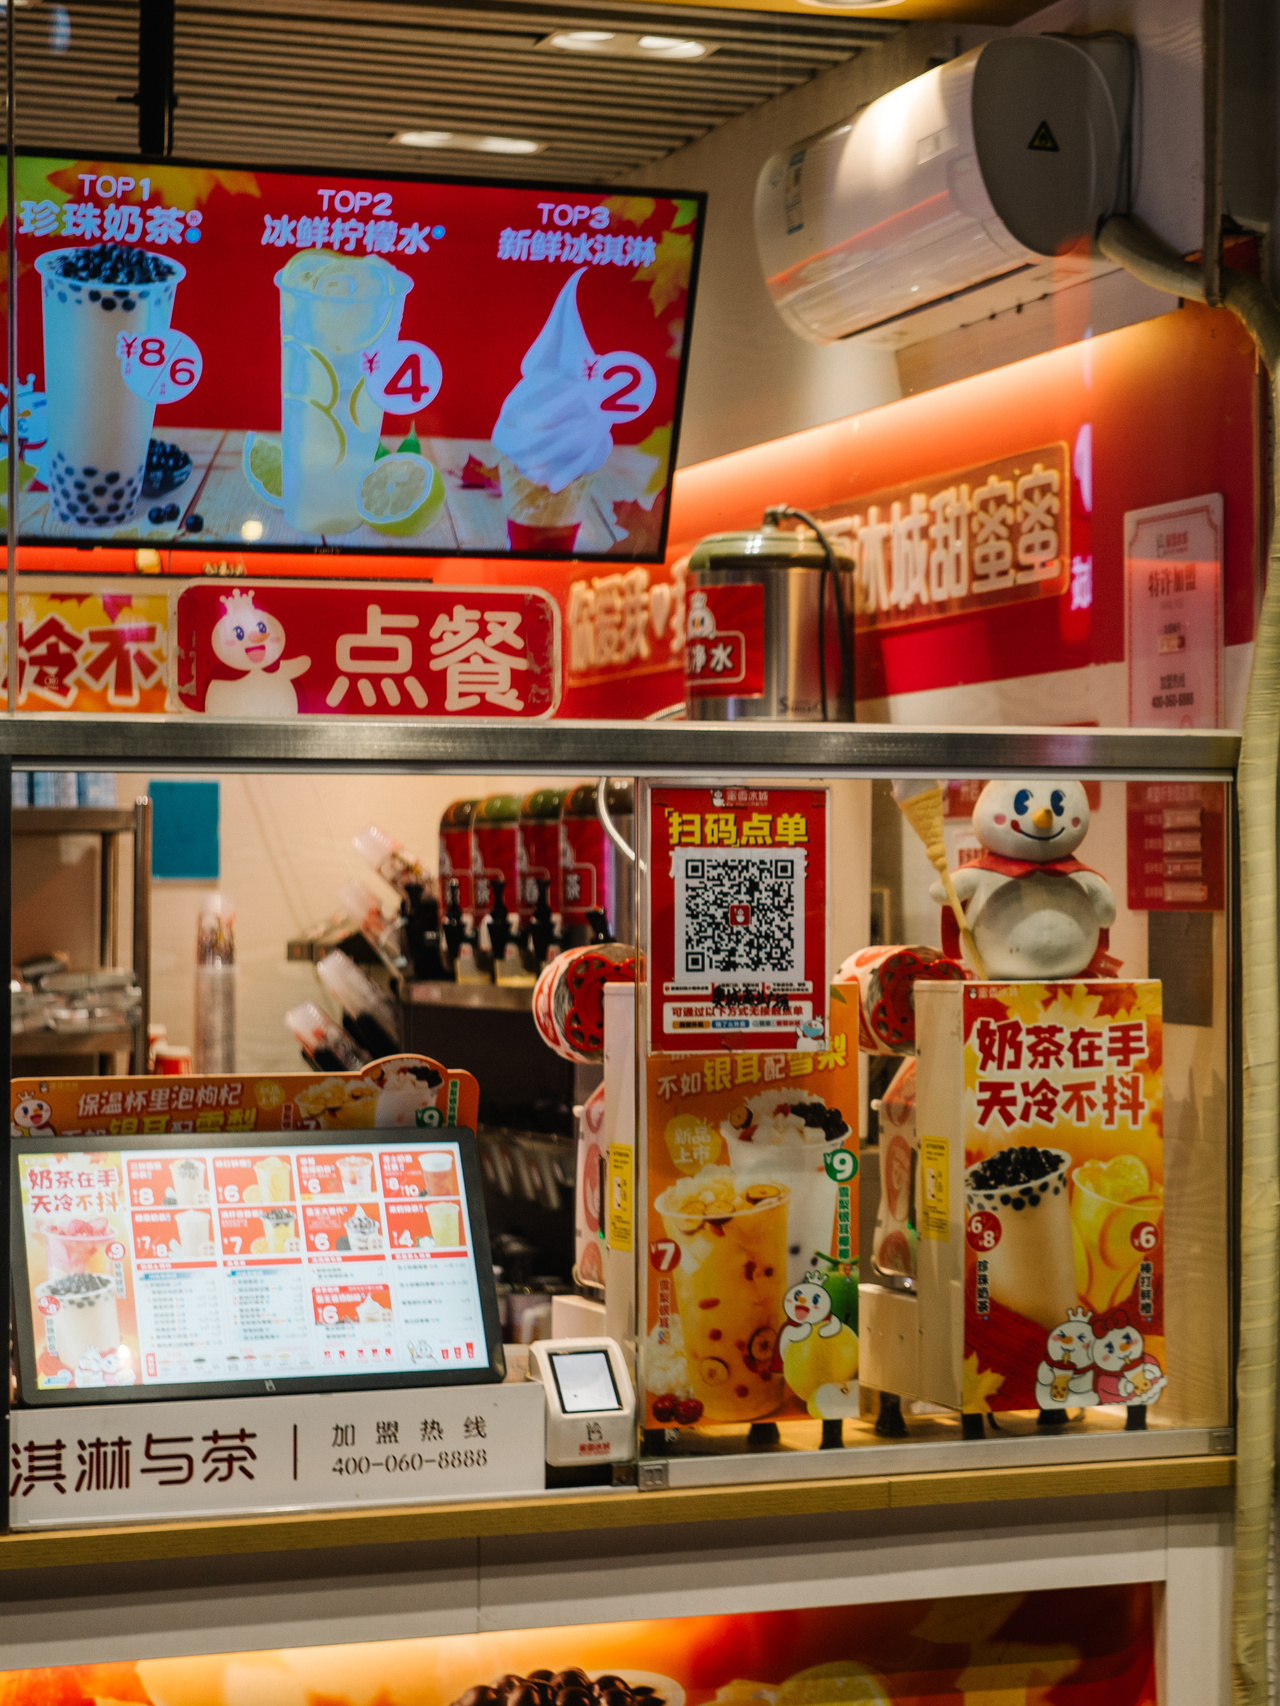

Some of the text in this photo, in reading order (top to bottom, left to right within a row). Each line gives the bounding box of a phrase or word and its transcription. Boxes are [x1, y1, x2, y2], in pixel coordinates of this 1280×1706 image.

[78, 174, 150, 201] TOP1
[317, 189, 393, 216] TOP2
[19, 200, 185, 244] 珍珠奶茶
[537, 203, 611, 229] TOP3
[261, 214, 430, 255] 冰鲜柠檬水
[498, 228, 657, 268] 新鲜冰淇淋
[326, 603, 528, 712] 点餐
[976, 1019, 1146, 1072] 奶茶在手
[78, 1083, 244, 1117] 保温杯里泡枸杞
[976, 1074, 1146, 1127] 天冷不抖
[28, 1168, 119, 1190] 奶茶在手
[30, 1192, 119, 1214] 天冷不抖
[332, 1416, 487, 1447] 加盟热线
[10, 1427, 257, 1496] 淇淋与茶
[332, 1449, 488, 1475] 400-060-8888
